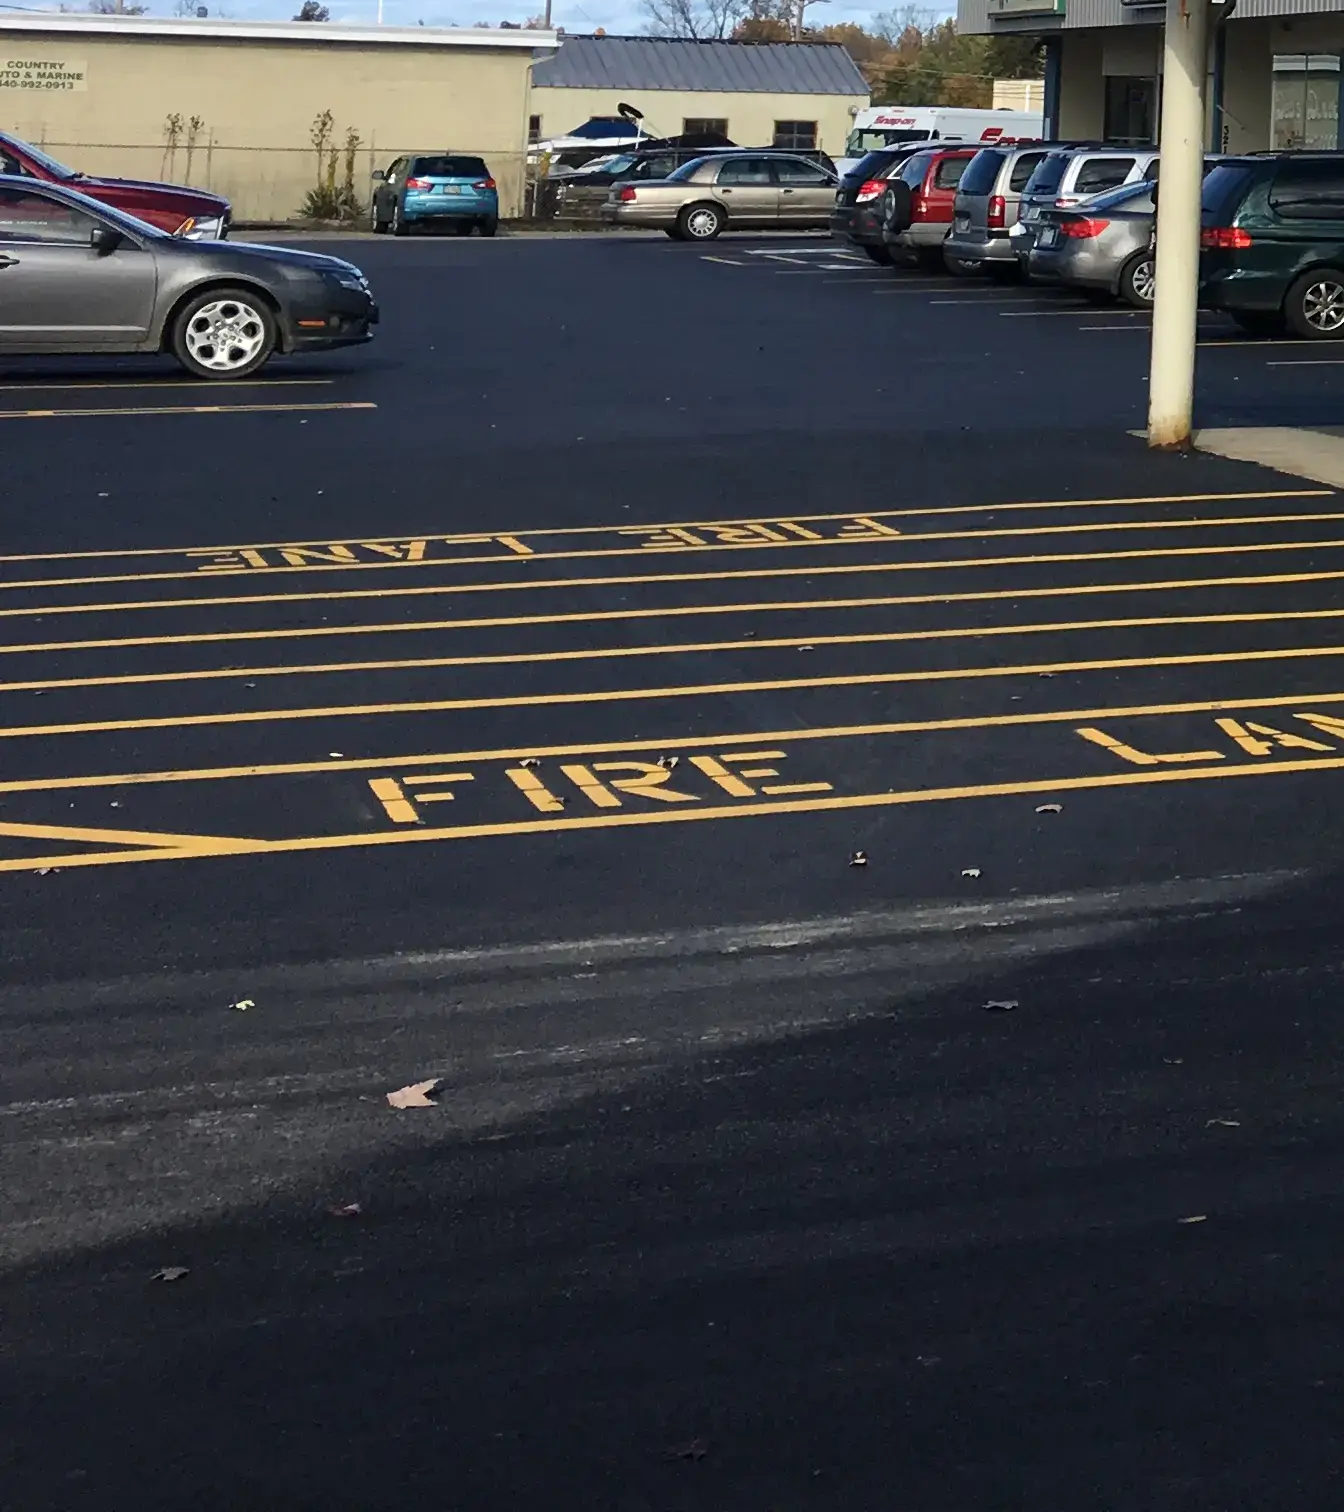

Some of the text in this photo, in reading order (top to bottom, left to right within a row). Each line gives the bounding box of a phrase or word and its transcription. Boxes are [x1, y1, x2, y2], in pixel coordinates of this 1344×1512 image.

[7, 60, 65, 69] COUNTRY
[24, 71, 32, 79] &
[37, 72, 83, 80] MARINE
[0, 80, 74, 90] 40-992-0913
[873, 115, 916, 126] Snap-on
[185, 517, 903, 571] FIRE LANE
[368, 750, 833, 824] FIRE
